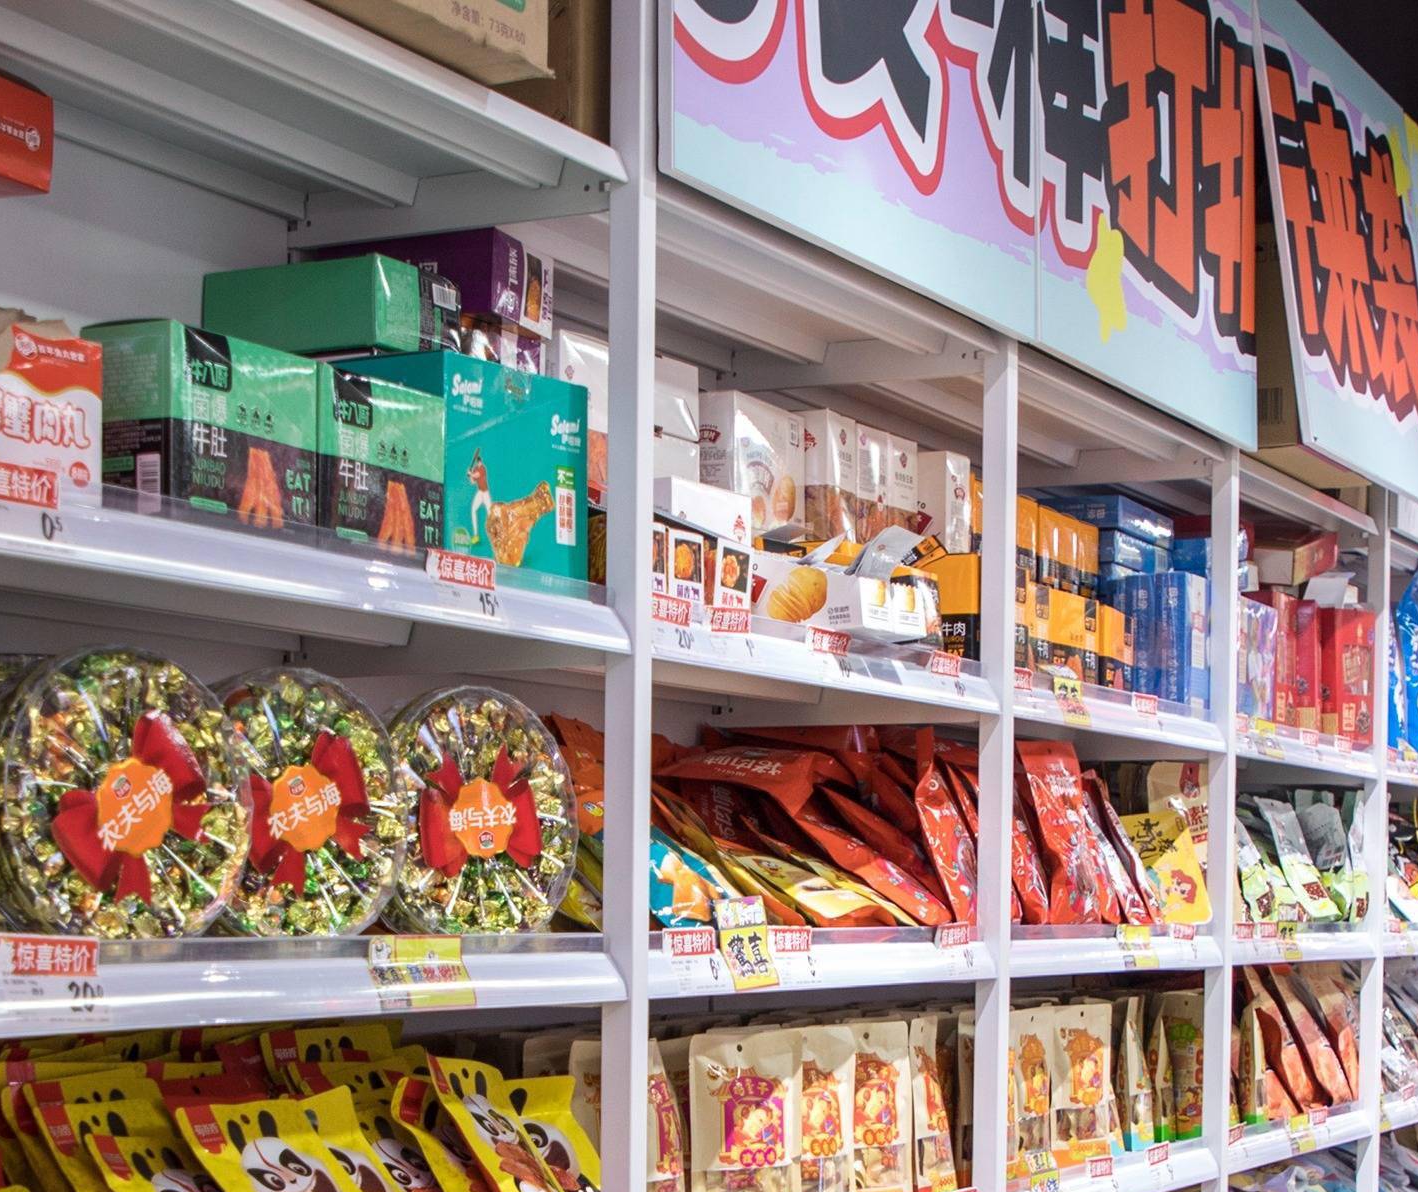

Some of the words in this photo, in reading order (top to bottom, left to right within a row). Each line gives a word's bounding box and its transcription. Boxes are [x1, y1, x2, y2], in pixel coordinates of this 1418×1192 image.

[191, 425, 229, 459] 牛肚
[338, 457, 370, 493] 牛肚
[442, 540, 494, 589] 惊喜特价!
[941, 621, 966, 637] 牛肉
[96, 768, 176, 853] 农夫与海
[266, 779, 343, 841] 农夫与海
[448, 799, 519, 833] 农夫与海
[12, 942, 97, 975] 惊喜特价!
[673, 931, 714, 954] 惊喜特价!
